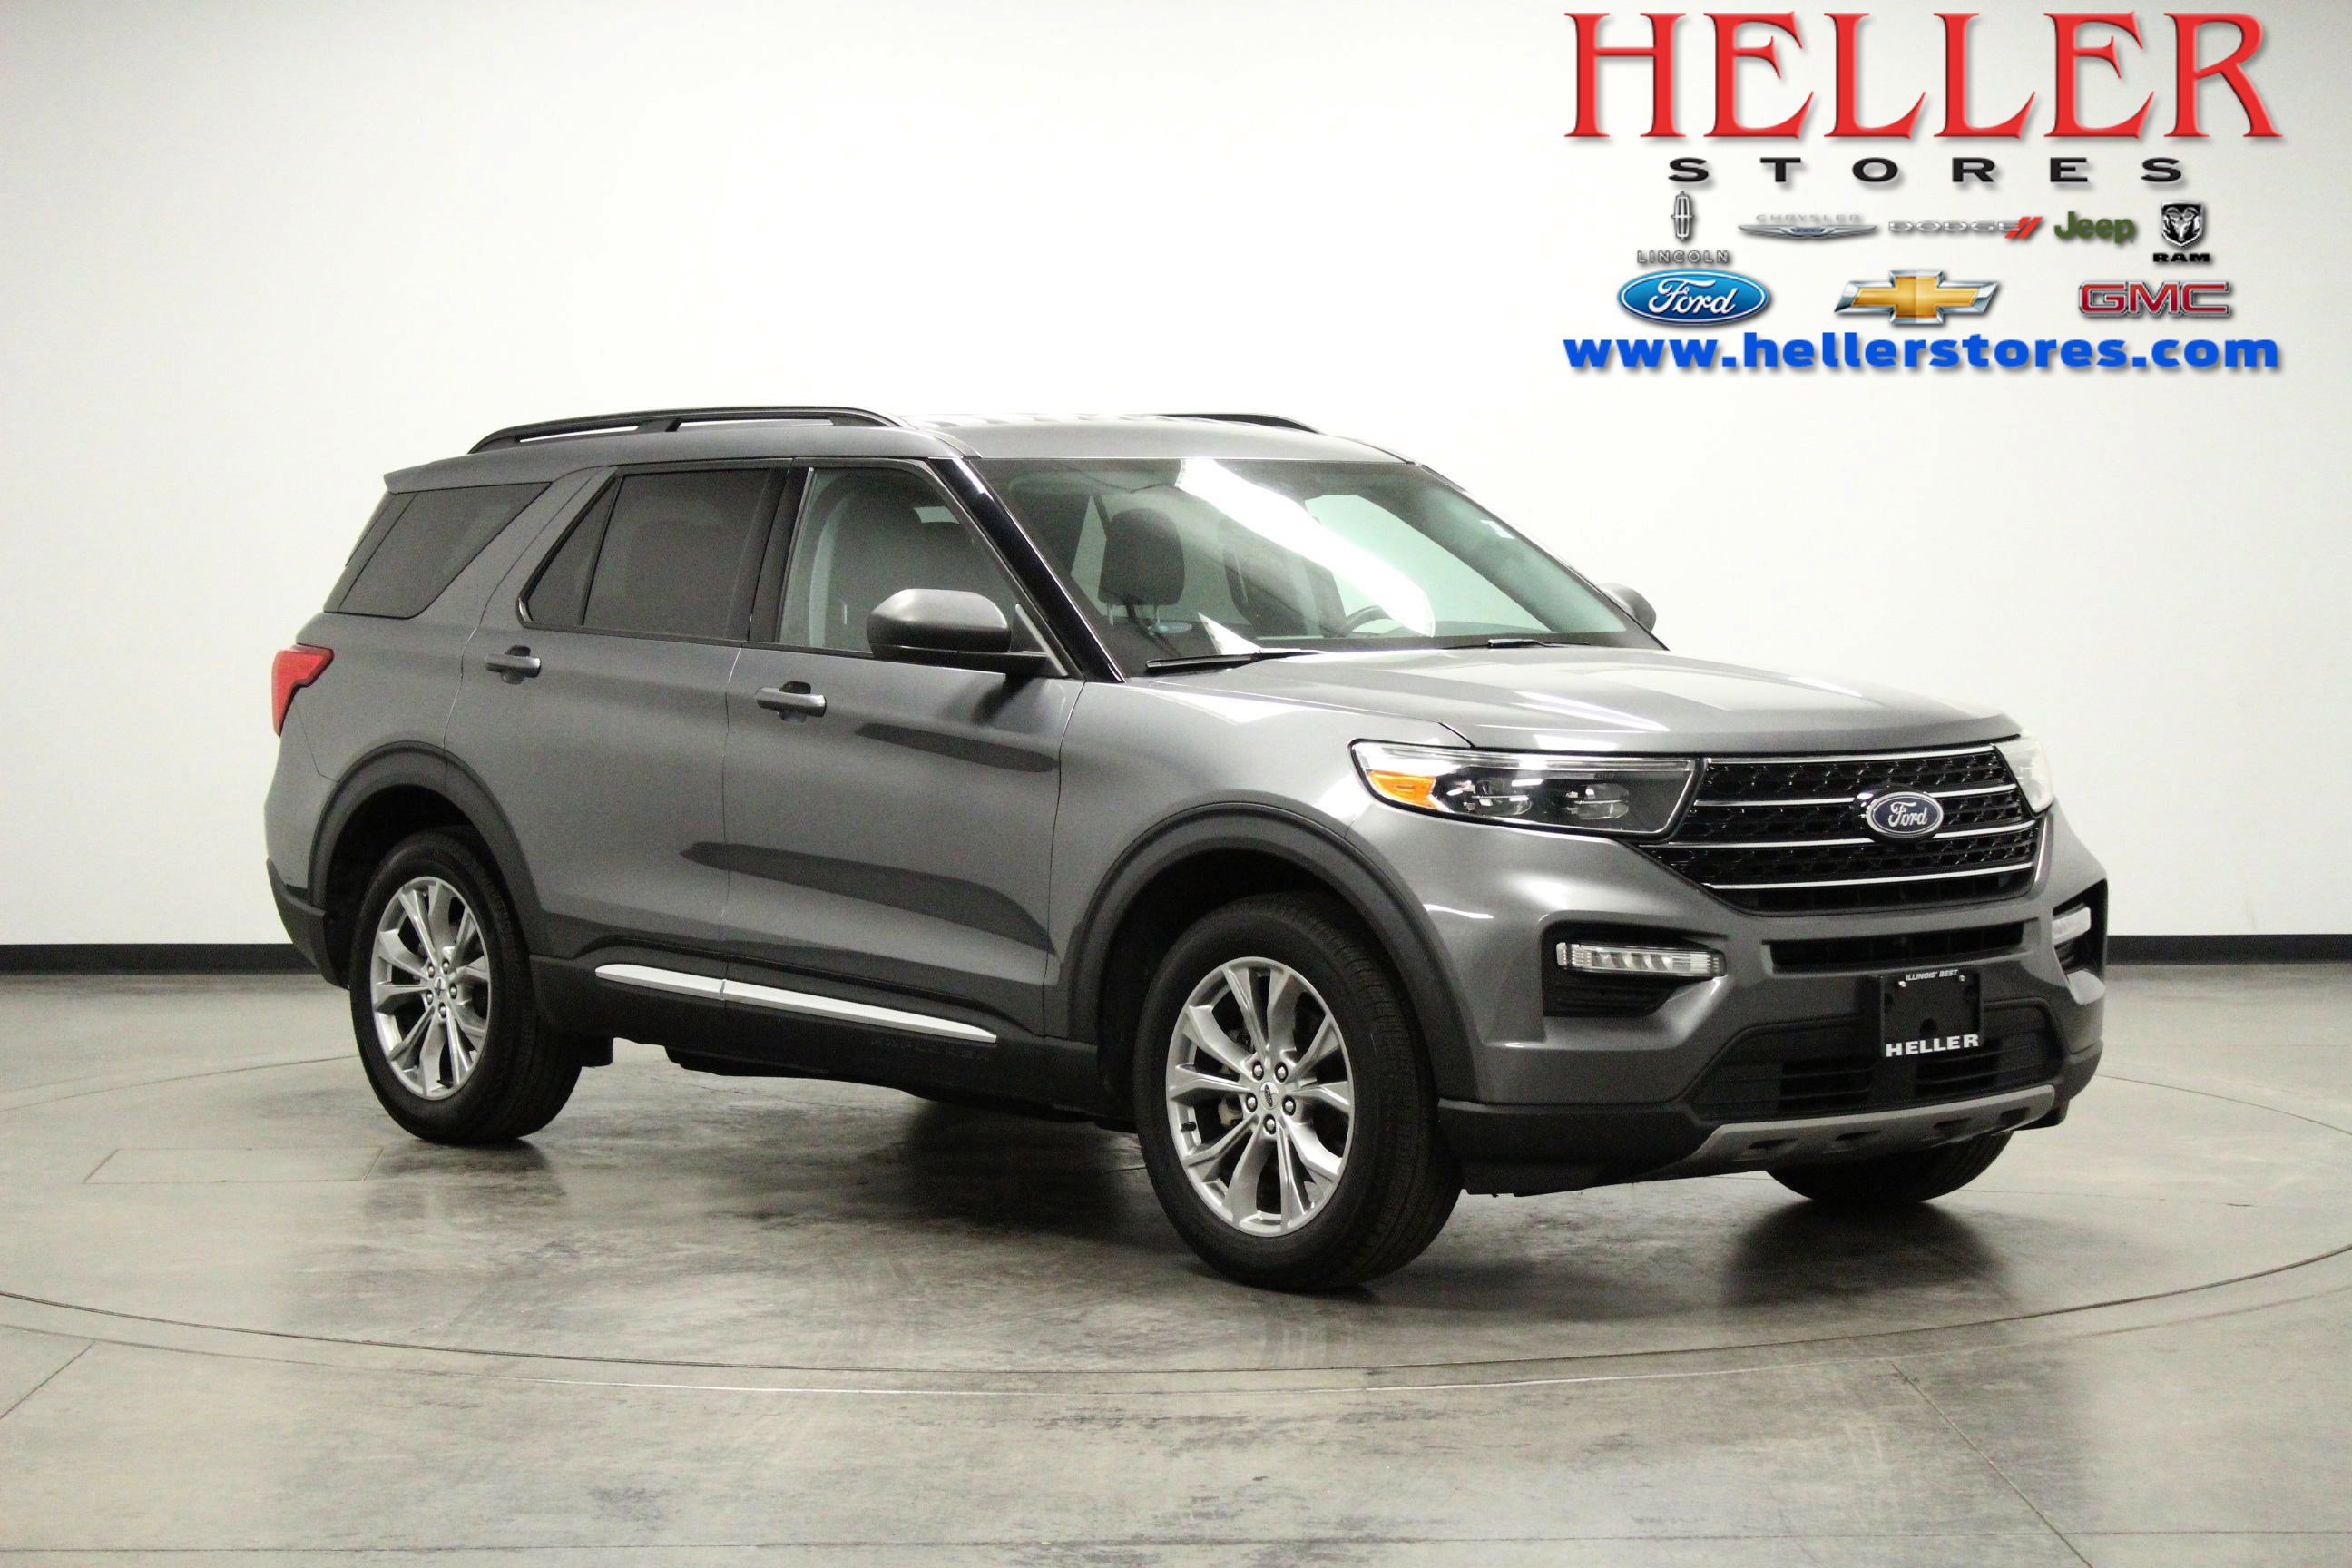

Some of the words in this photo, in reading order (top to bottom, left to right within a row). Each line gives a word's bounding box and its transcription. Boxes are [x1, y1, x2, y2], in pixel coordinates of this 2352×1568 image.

[1887, 801, 1928, 828] Ford
[1939, 969, 1958, 977] BEST
[1886, 1034, 1978, 1057] HELLER
